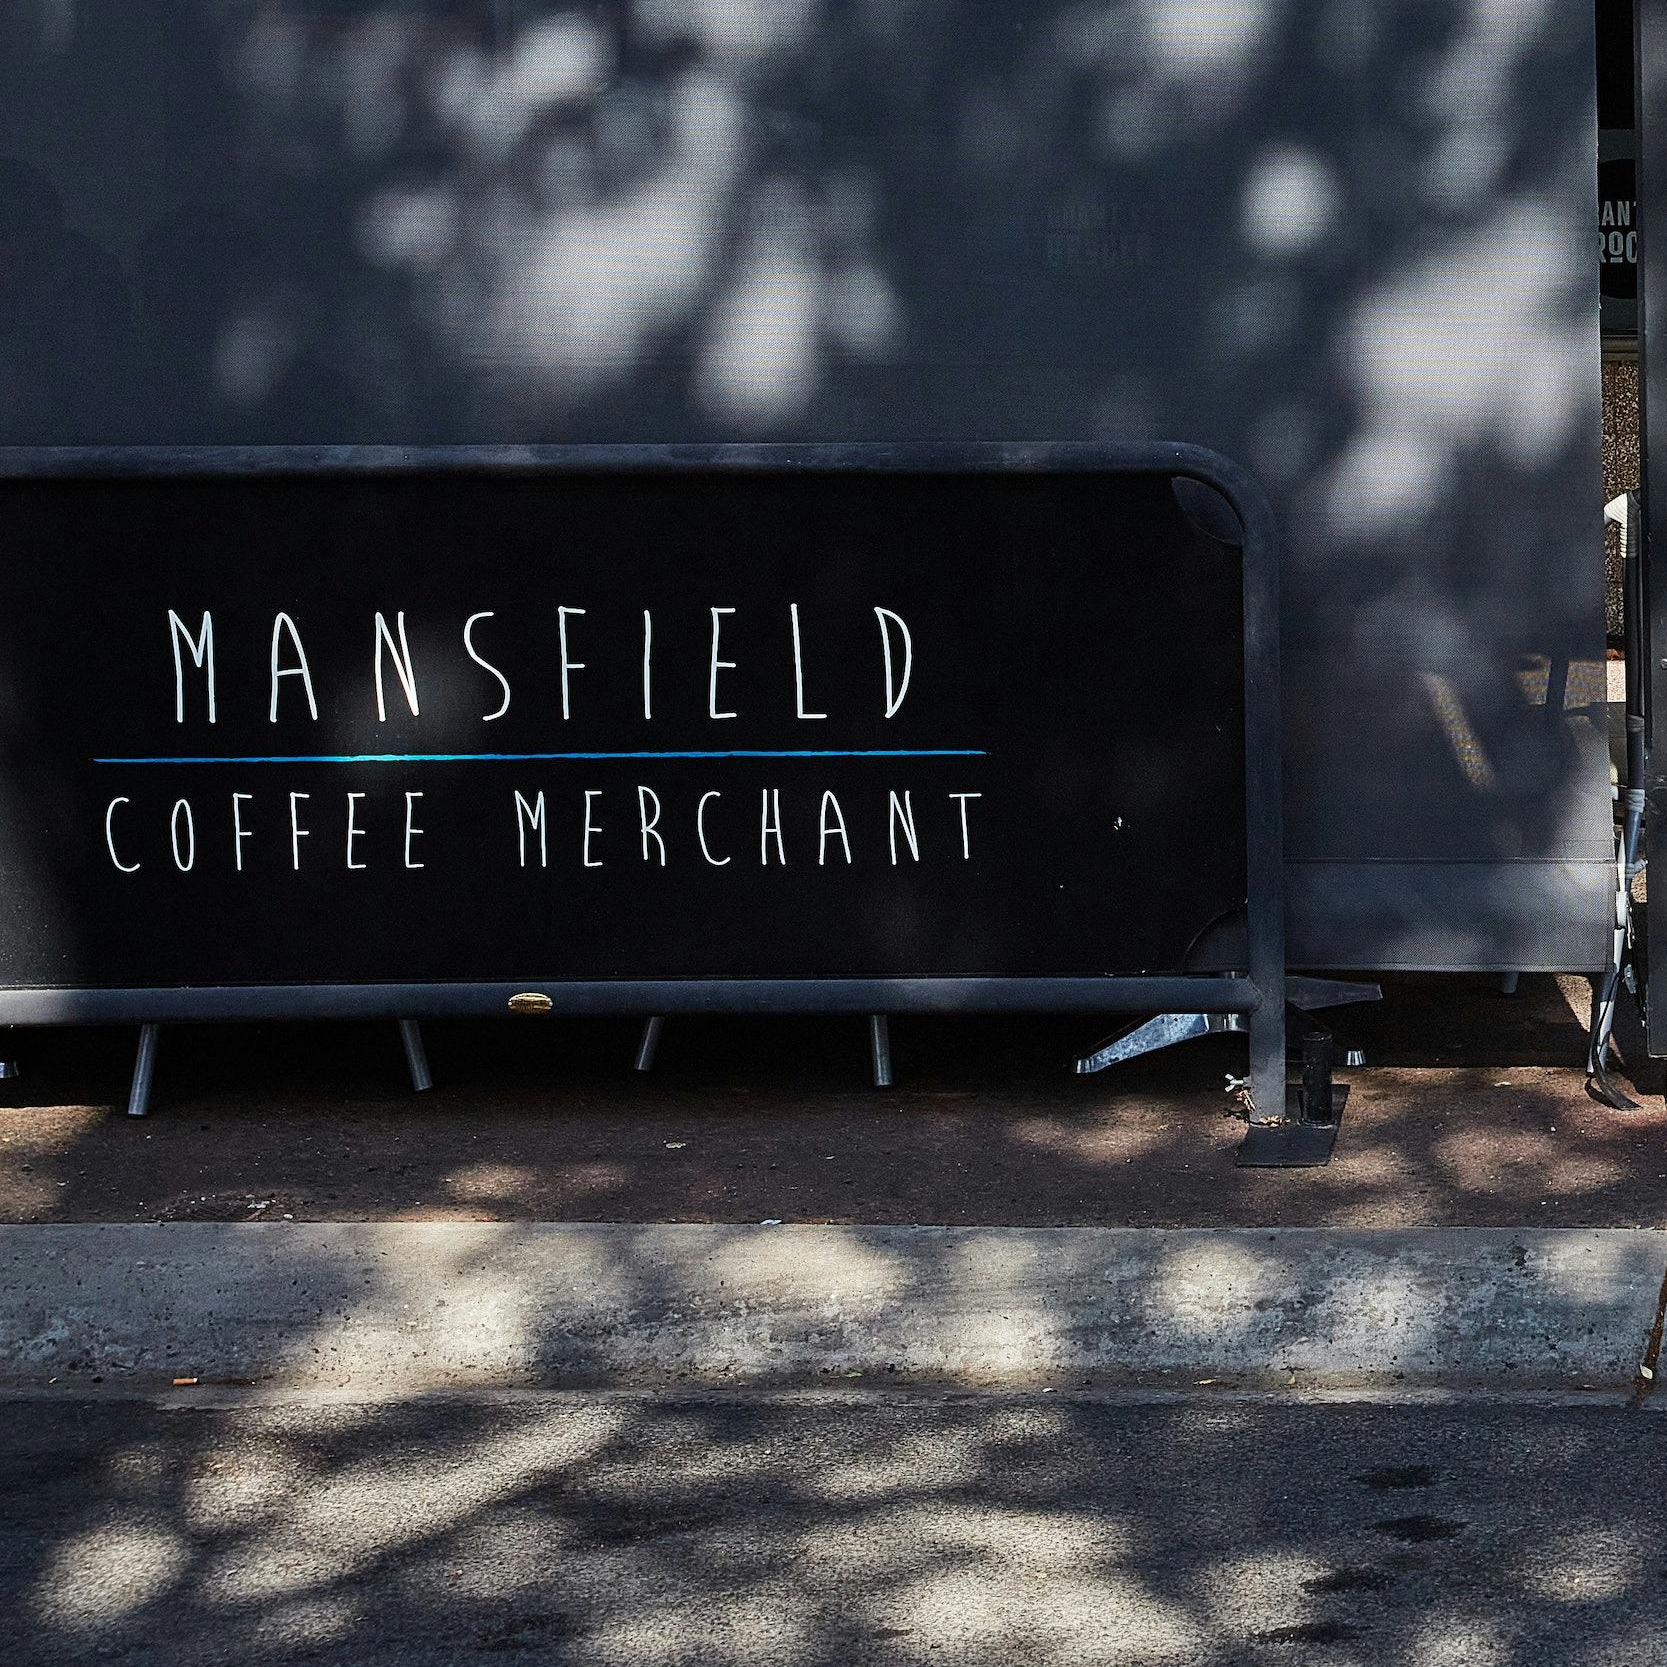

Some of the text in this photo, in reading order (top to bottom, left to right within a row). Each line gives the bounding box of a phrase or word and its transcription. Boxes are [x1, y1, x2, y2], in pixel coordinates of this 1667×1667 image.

[166, 605, 914, 724] MANSFIELD
[104, 784, 985, 873] COFFEE MERCHANT
